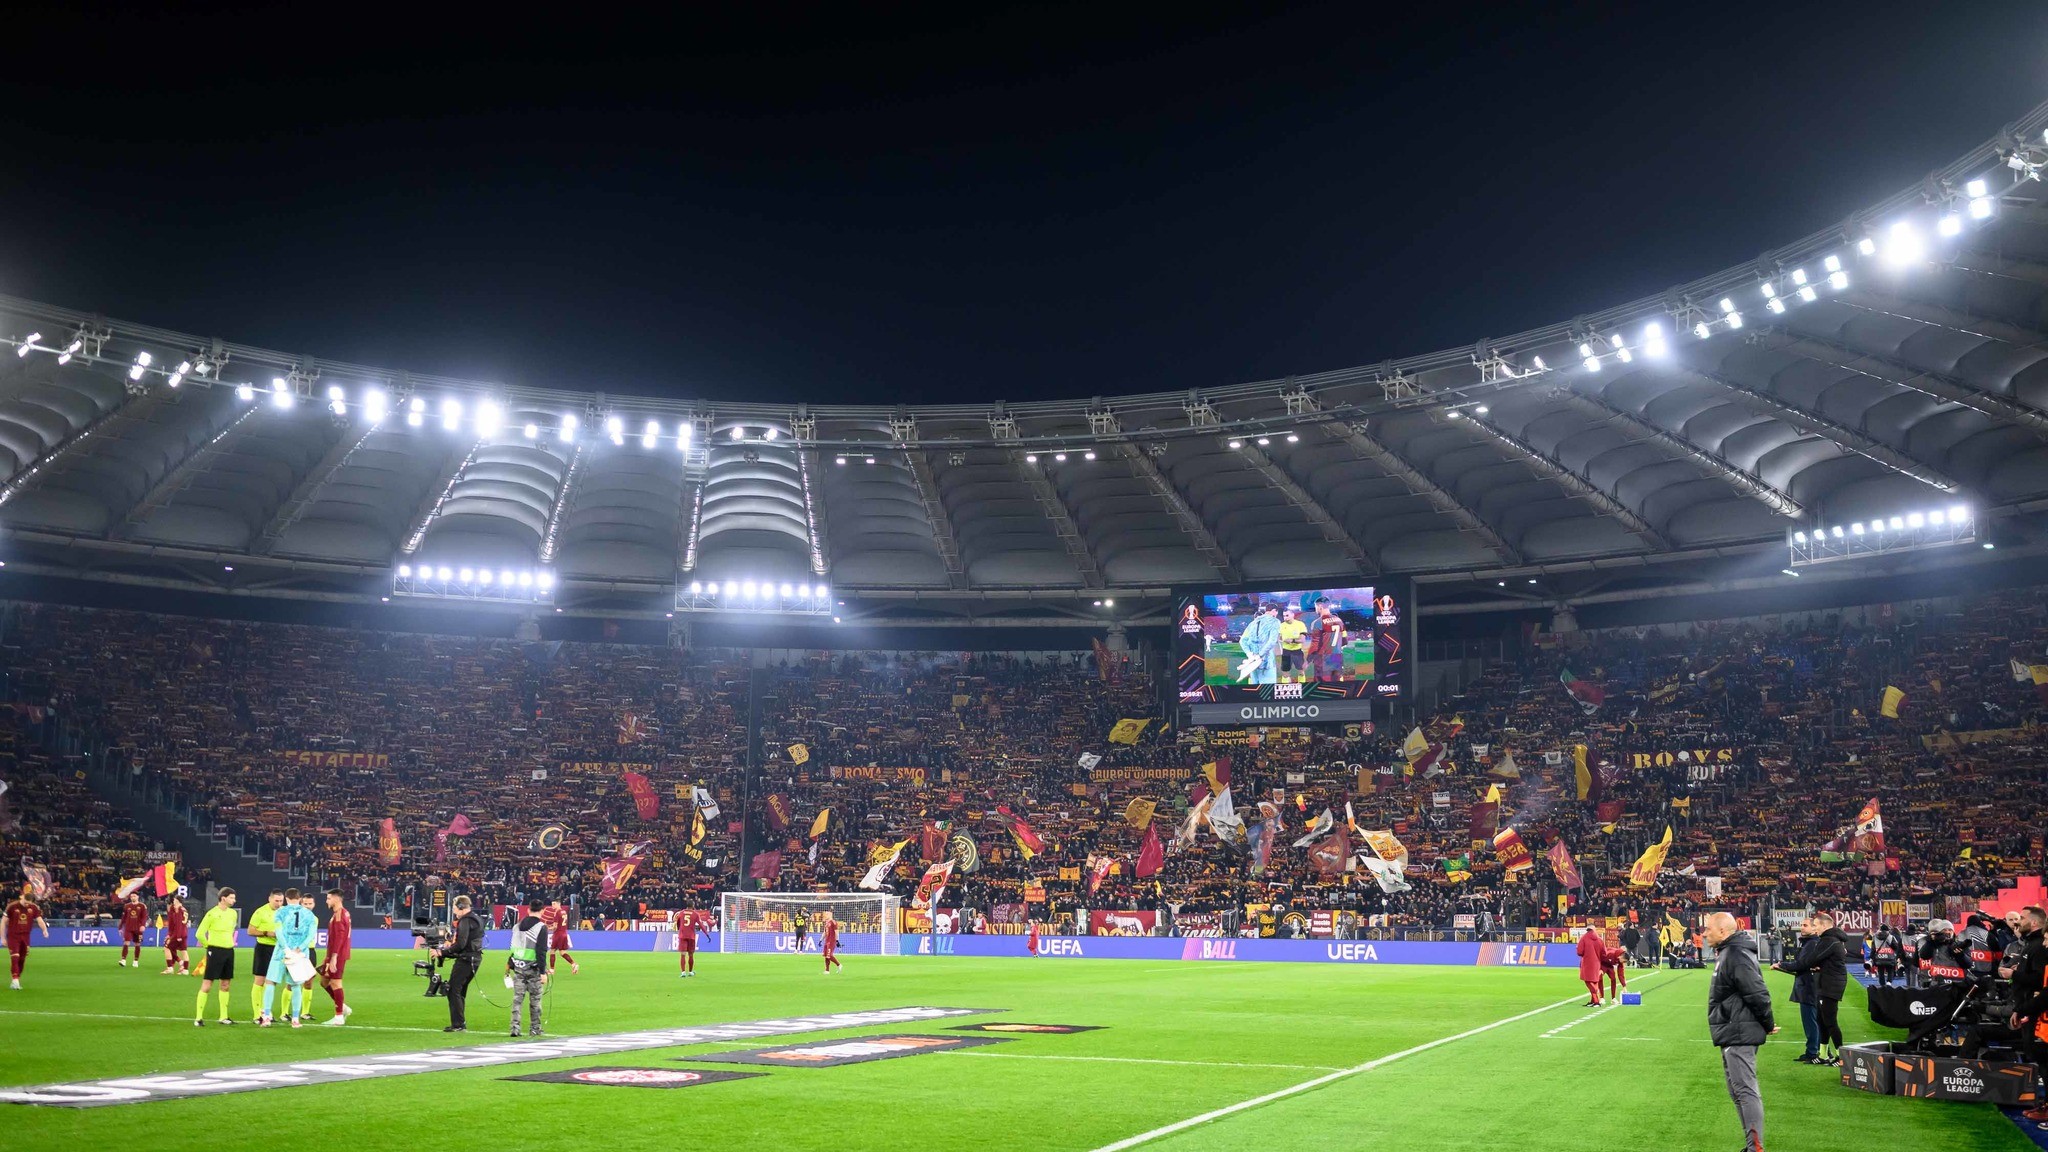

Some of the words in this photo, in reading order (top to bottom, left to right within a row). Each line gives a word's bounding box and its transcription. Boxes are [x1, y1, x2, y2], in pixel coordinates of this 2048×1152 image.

[1331, 625, 1341, 647] 7
[1377, 684, 1399, 692] 00:01
[1240, 704, 1320, 720] OLIMPICO
[1217, 730, 1247, 738] ROMA
[1633, 748, 1733, 769] BOYS
[1882, 901, 1906, 915] AVE
[293, 911, 300, 930] 1
[683, 914, 691, 927] 5
[72, 930, 108, 944] UEFA
[1037, 939, 1084, 955] UEFA
[1327, 943, 1378, 961] UEFA
[1518, 945, 1547, 965] ALL
[1918, 1006, 1937, 1016] NEP
[0, 1063, 430, 1102] UEFA
[373, 1030, 774, 1064] EUROPA
[1853, 1066, 1868, 1076] EUROPA
[1953, 1066, 1974, 1077] UEFA
[1855, 1074, 1868, 1083] LEAGUE
[1943, 1076, 1984, 1088] EUROPA
[1946, 1084, 1981, 1094] LEAGUE
